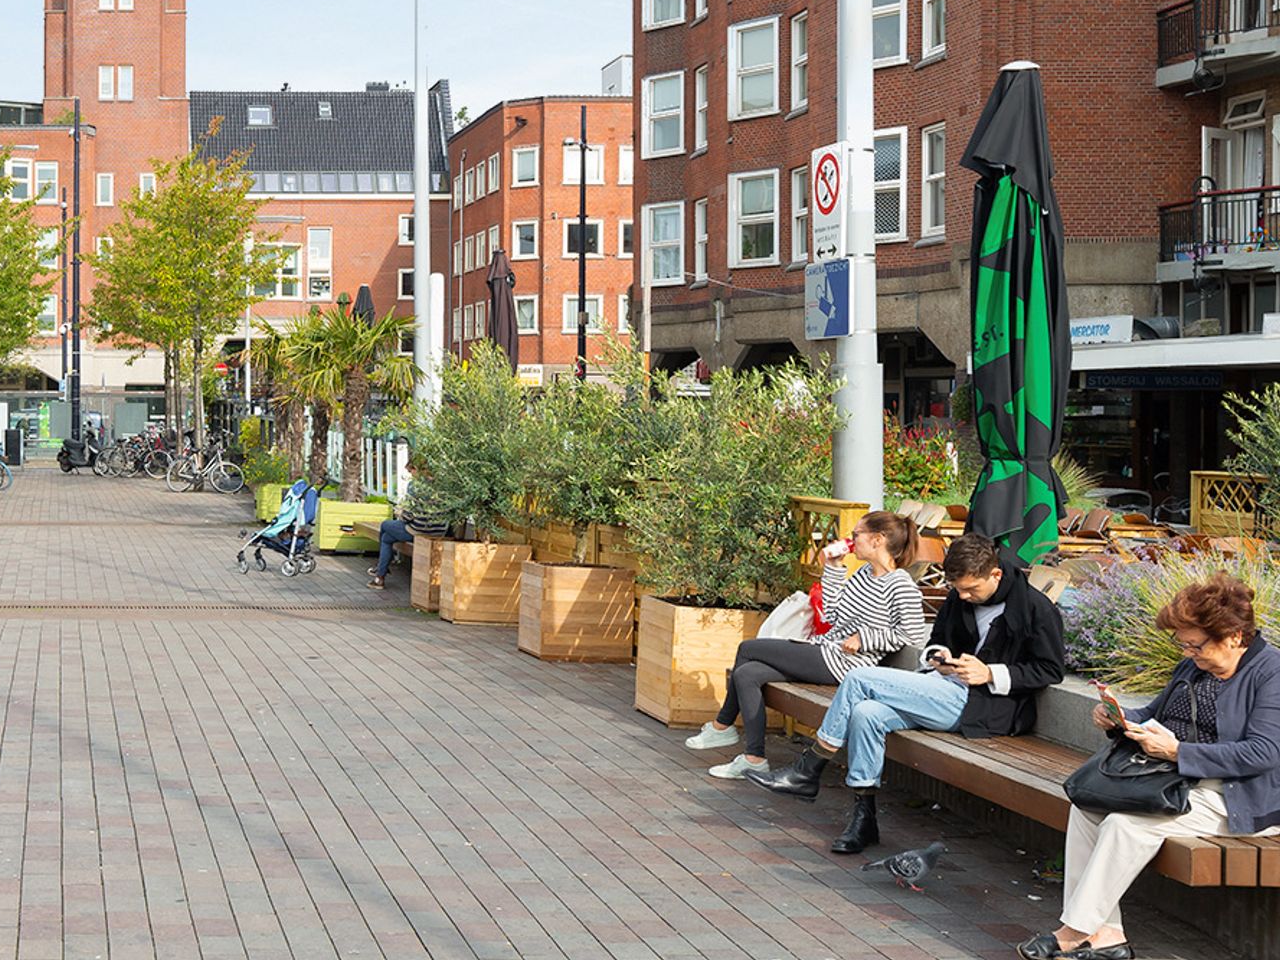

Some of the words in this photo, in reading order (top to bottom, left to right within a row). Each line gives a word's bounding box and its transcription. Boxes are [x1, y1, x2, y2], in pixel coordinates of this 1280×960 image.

[1071, 323, 1111, 337] MERCATOR
[1088, 374, 1146, 386] STOMERIJ
[1154, 374, 1220, 386] WASSALON
